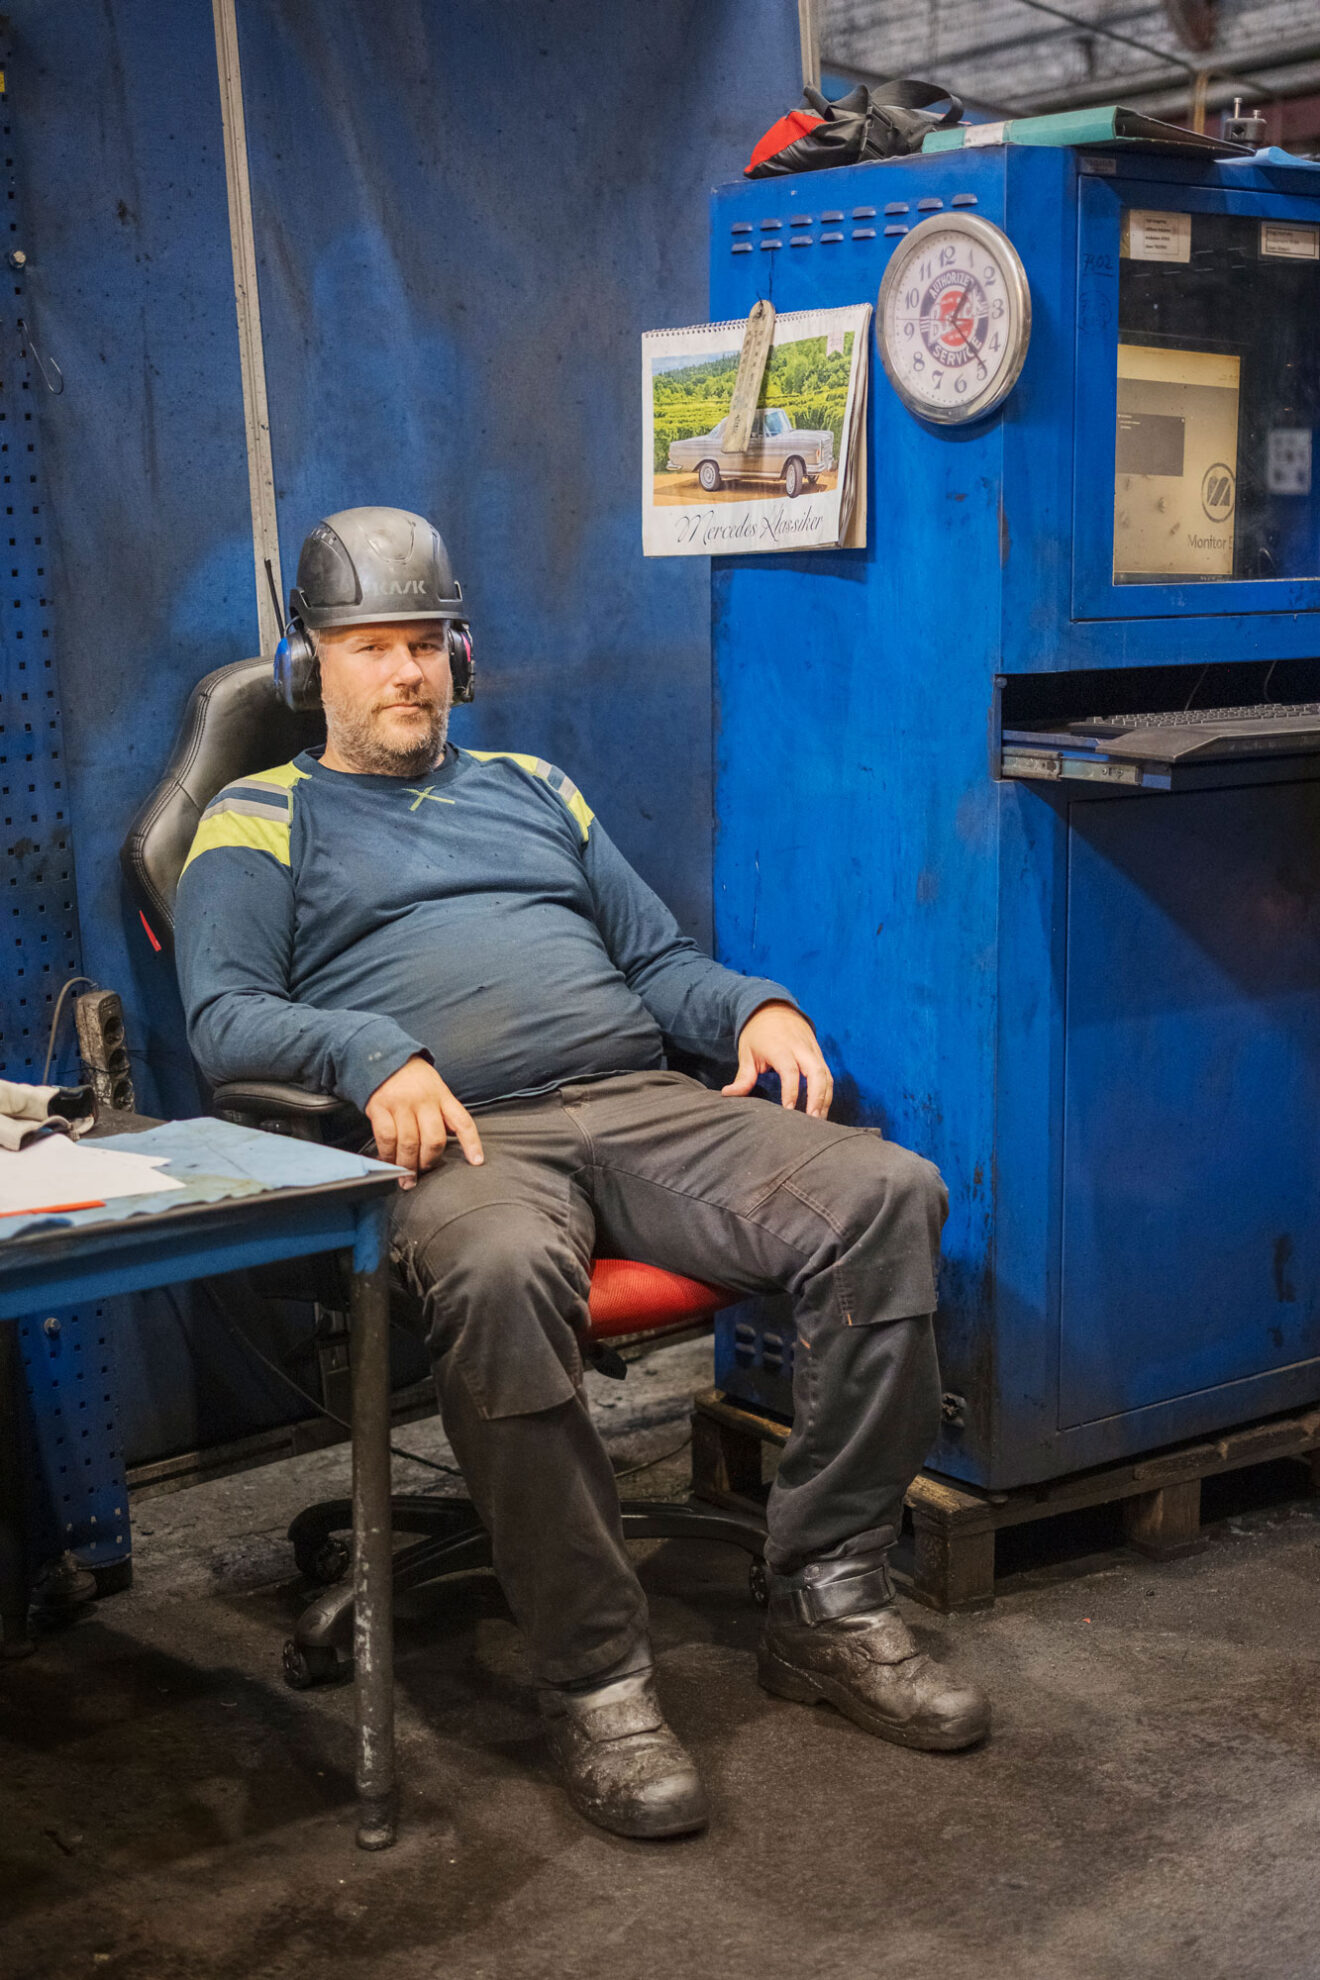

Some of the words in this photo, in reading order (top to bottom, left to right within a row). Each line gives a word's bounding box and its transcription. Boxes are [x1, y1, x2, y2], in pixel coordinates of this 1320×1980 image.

[940, 245, 955, 267] 12
[920, 261, 931, 282] 11
[984, 266, 996, 286] 2
[905, 288, 919, 310] 10
[992, 299, 1004, 320] 3
[904, 322, 915, 342] 9
[989, 331, 1000, 352] 4
[933, 335, 982, 366] SERVICE
[913, 351, 925, 372] 8
[932, 370, 944, 390] 7
[954, 373, 967, 394] 6
[674, 510, 757, 546] Mercedes
[1187, 534, 1227, 550] Monitor
